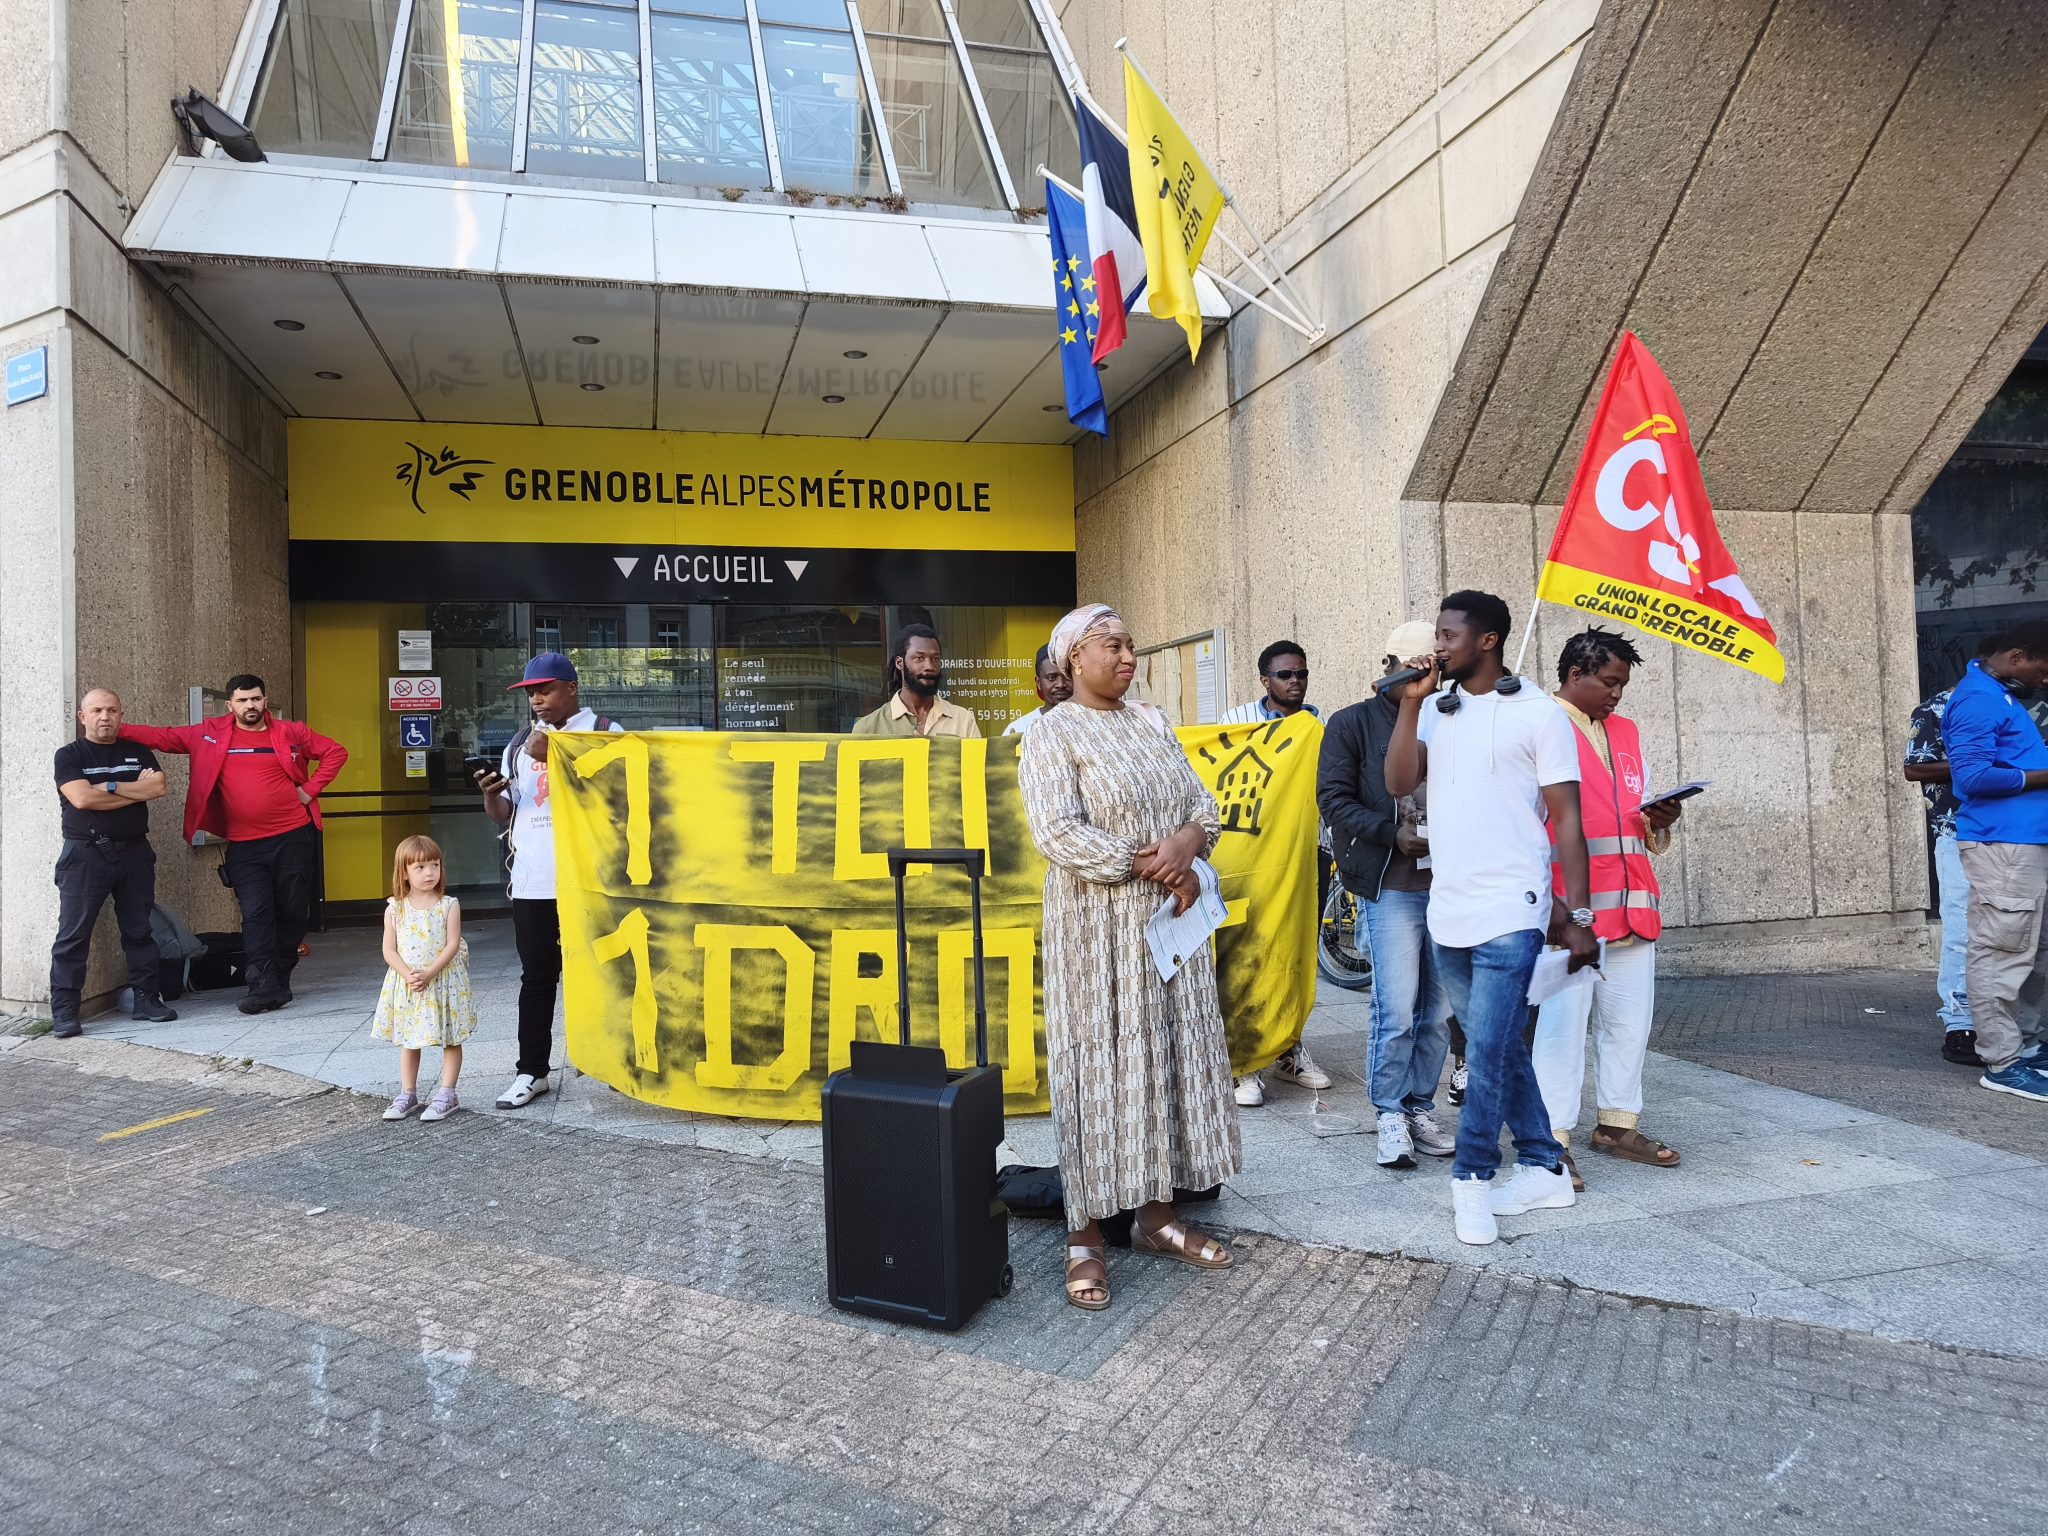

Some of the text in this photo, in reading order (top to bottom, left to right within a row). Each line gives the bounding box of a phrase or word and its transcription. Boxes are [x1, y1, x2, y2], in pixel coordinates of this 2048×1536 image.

[653, 554, 774, 583] ACCUEIL
[1574, 593, 1638, 620] GRAND
[1596, 582, 1740, 640] UNION LOCALE
[724, 657, 765, 668] Le seul
[940, 658, 1033, 669] ORAIRES D'OUVERTURE
[724, 672, 766, 683] remède
[947, 677, 956, 686] du
[958, 677, 977, 686] lundi
[989, 677, 1020, 685] vendredi
[724, 687, 753, 697] à ton
[724, 701, 796, 714] dérèglement
[977, 709, 991, 721] 59
[993, 709, 1007, 720] 59
[1009, 709, 1022, 720] 59
[725, 716, 780, 728] hormonal
[572, 737, 1021, 886] 1 TOI
[592, 908, 659, 1074] 1
